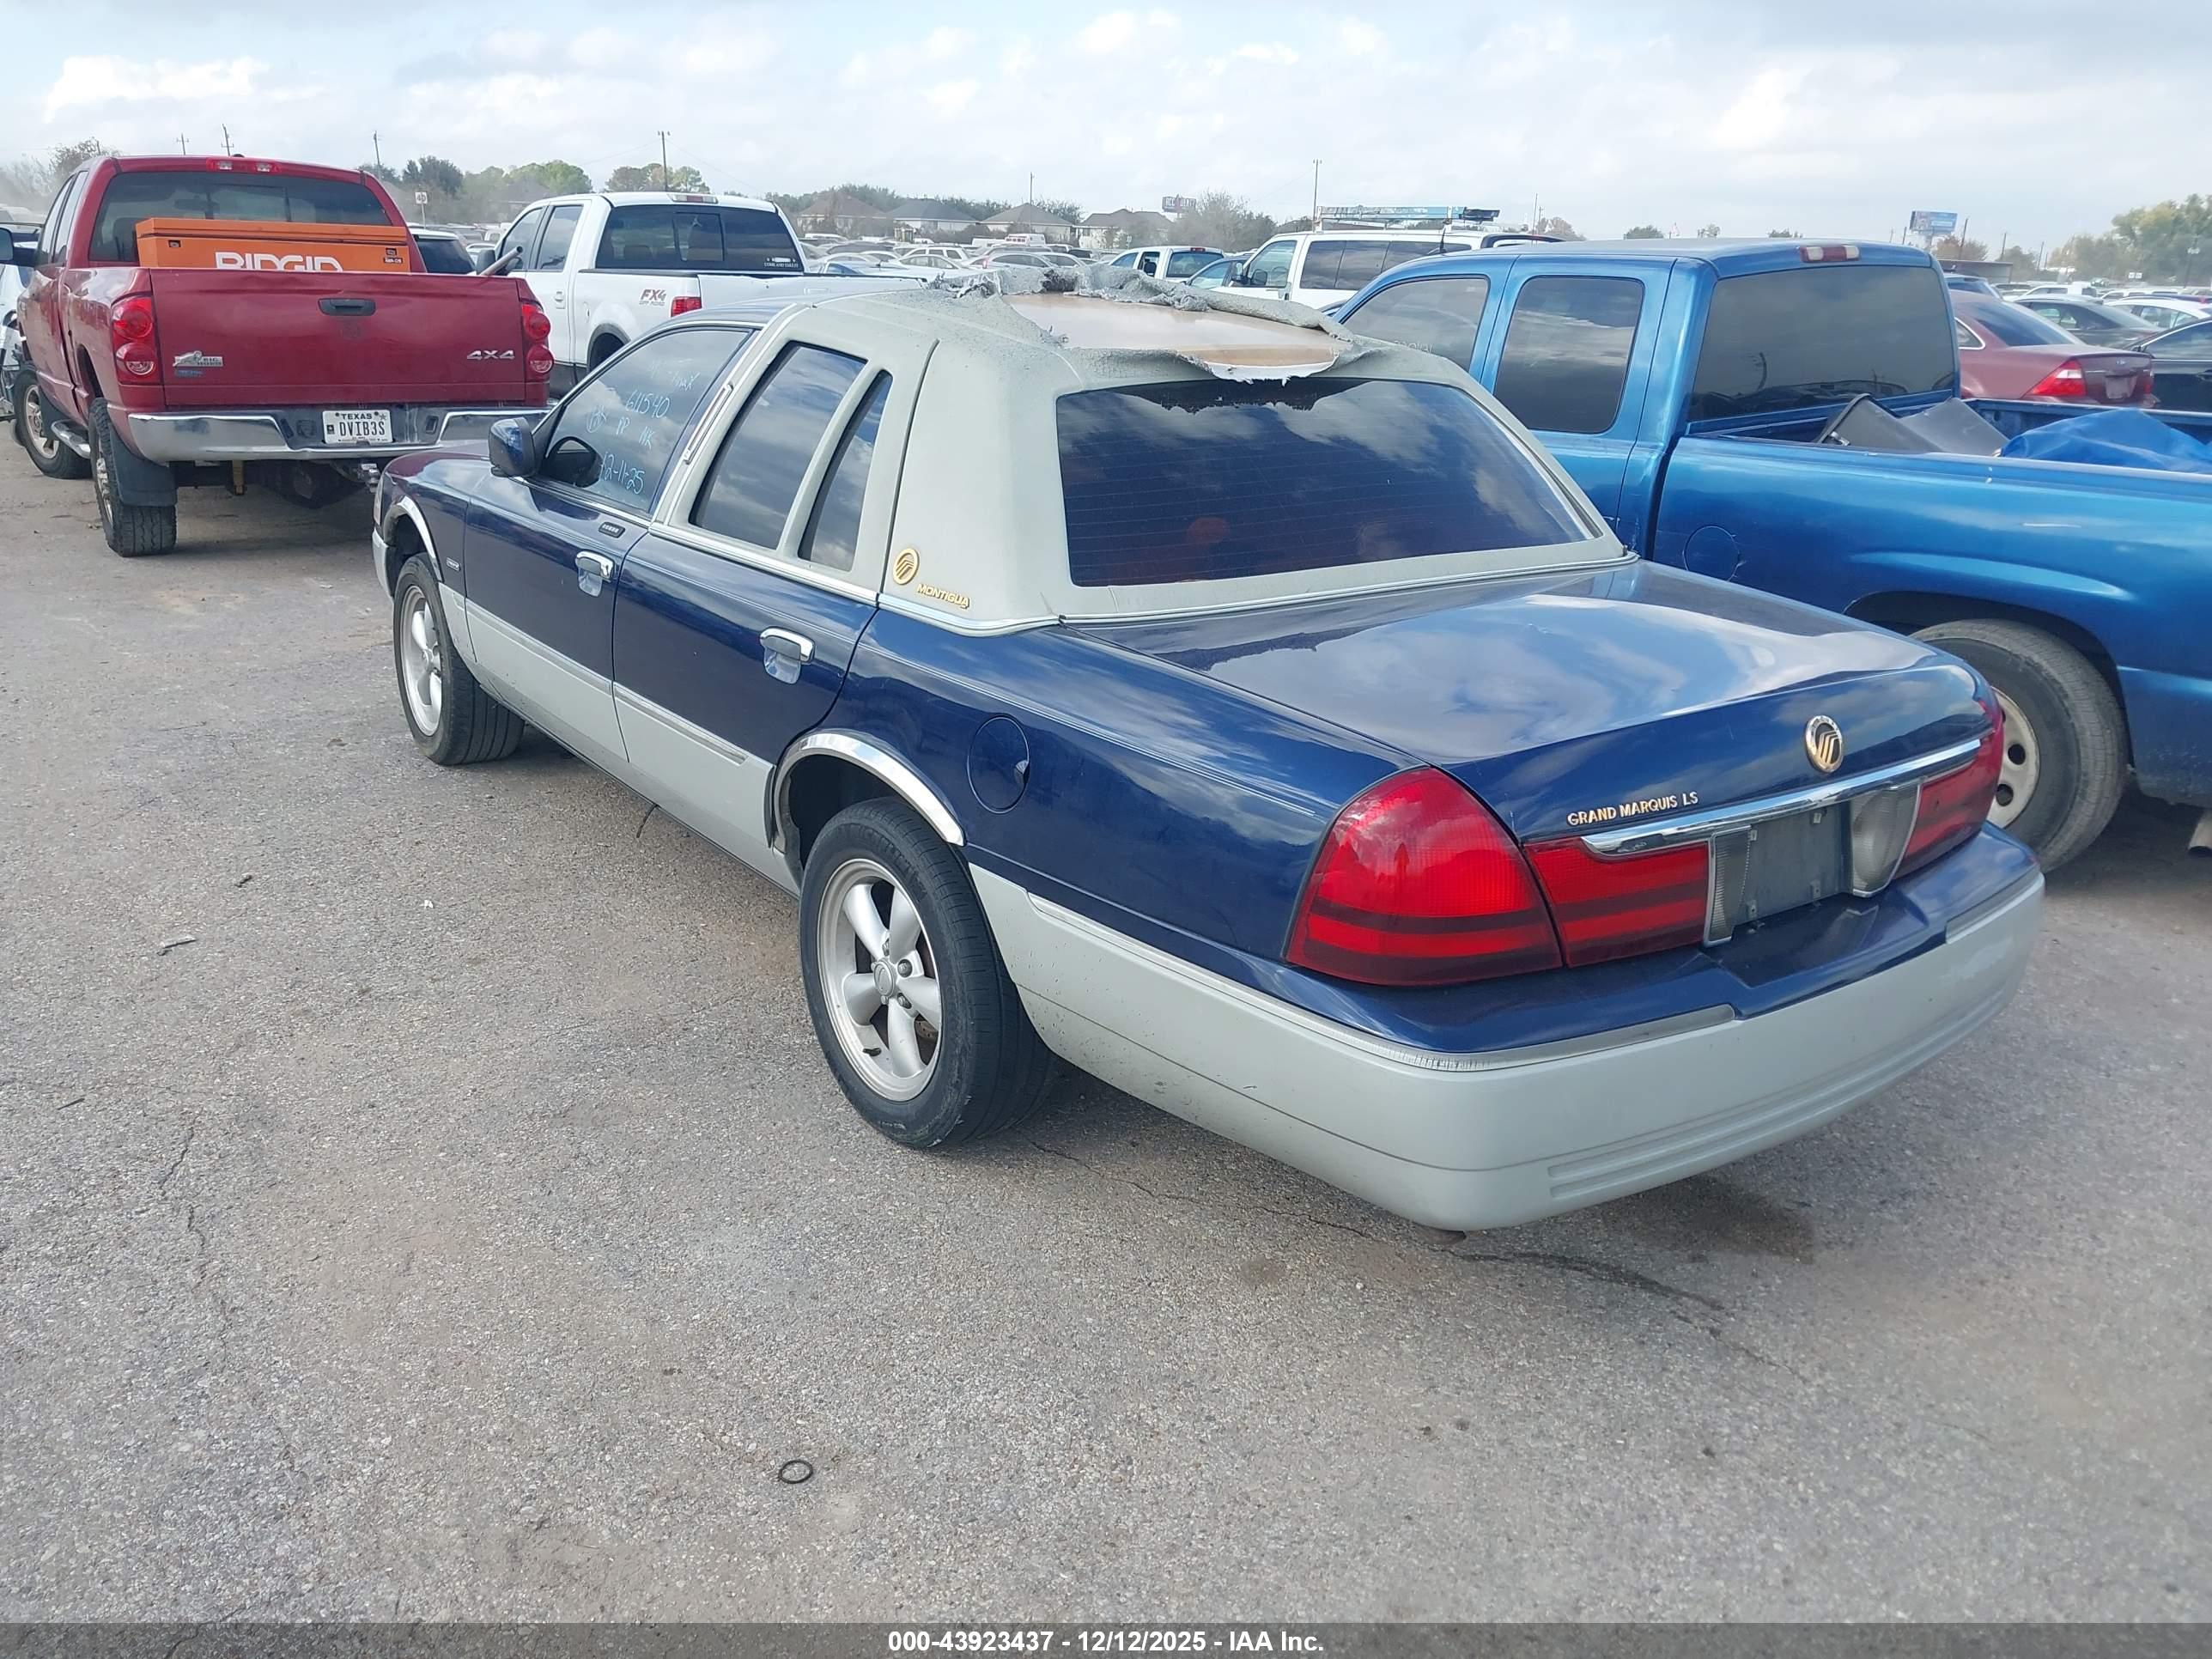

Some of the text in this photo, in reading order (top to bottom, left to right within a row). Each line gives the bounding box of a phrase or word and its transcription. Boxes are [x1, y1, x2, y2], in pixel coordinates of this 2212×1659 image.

[640, 289, 666, 301] FX4
[466, 349, 515, 361] 4X4
[1567, 791, 1698, 826] GRAND MARQUIS LS
